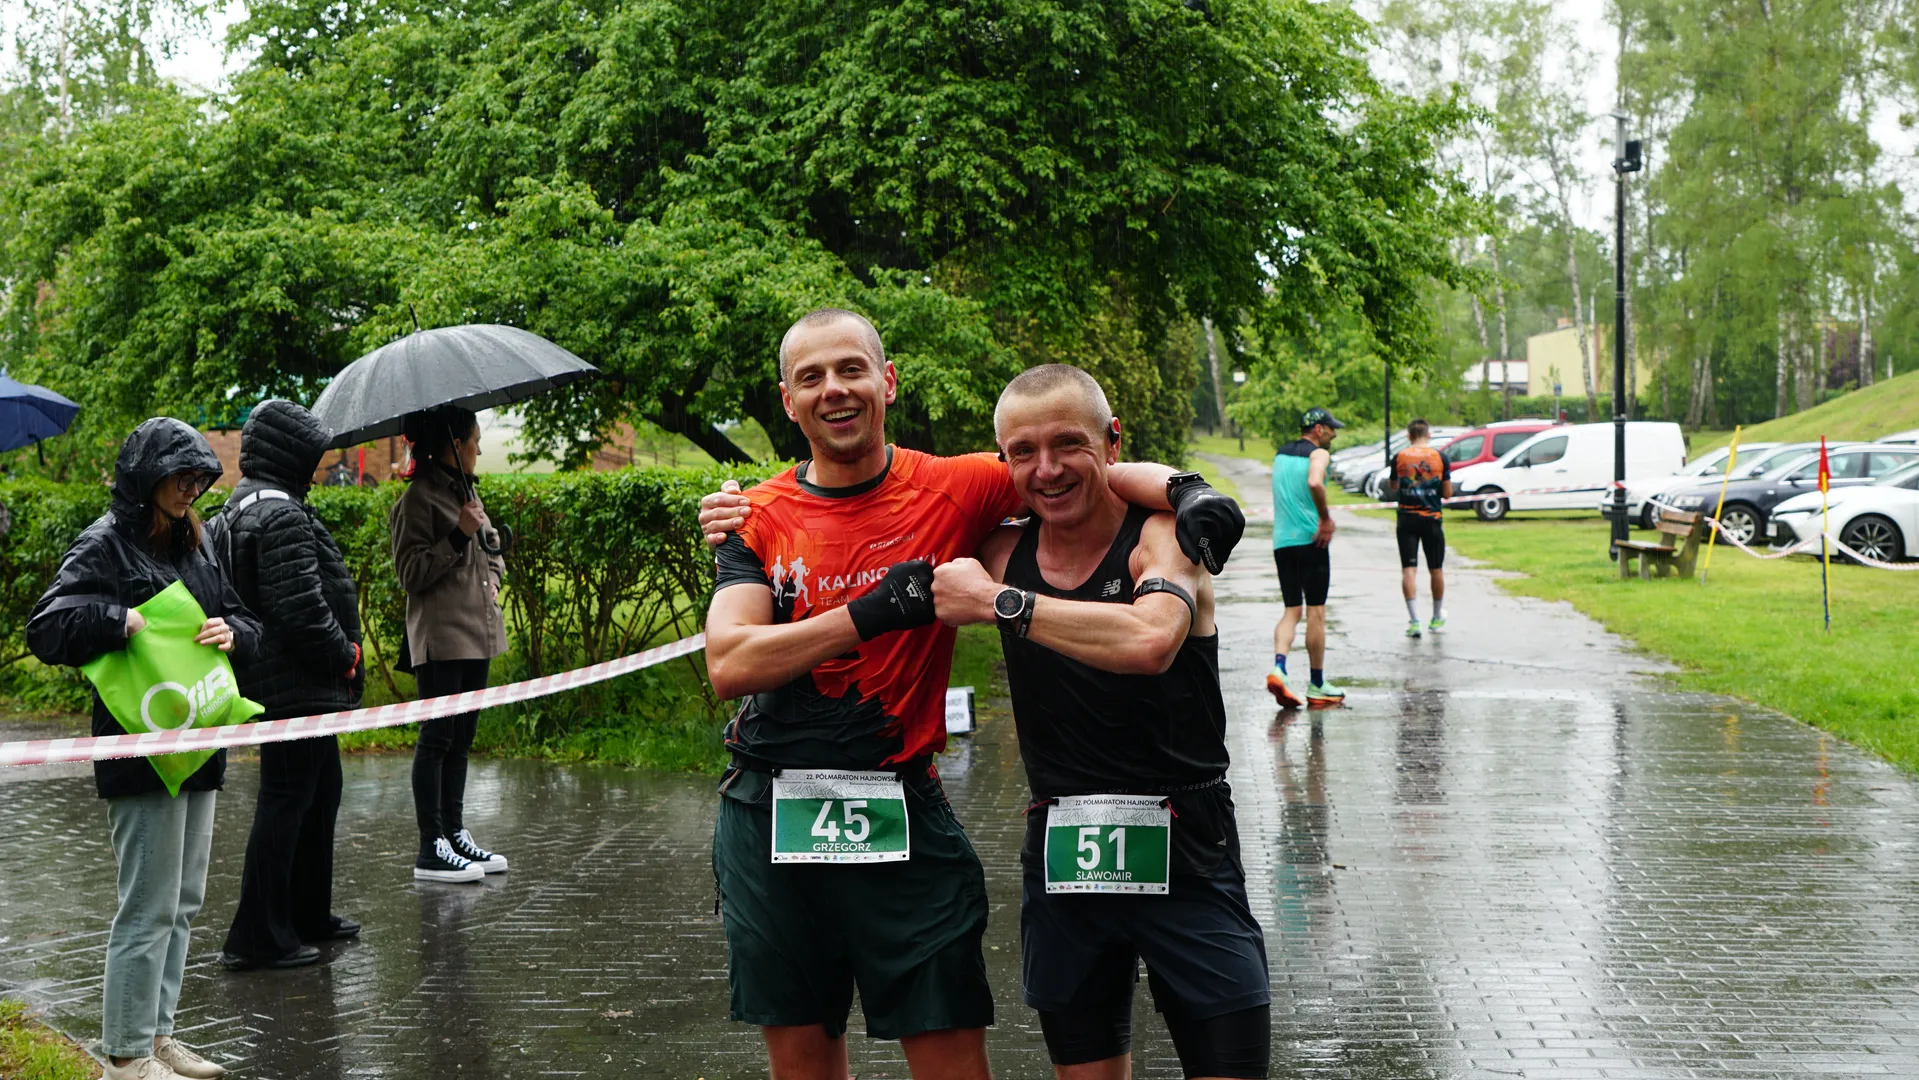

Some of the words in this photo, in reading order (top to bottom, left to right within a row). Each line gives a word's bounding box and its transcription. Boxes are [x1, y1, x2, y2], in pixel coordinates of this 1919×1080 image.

[815, 772, 859, 781] PÓŁMARATON
[1083, 798, 1126, 806] PÓŁMARATON
[811, 800, 871, 842] 45
[812, 842, 872, 852] GRZEGORZ
[1076, 827, 1126, 871] 51
[1076, 870, 1133, 881] SŁAWOMIR
